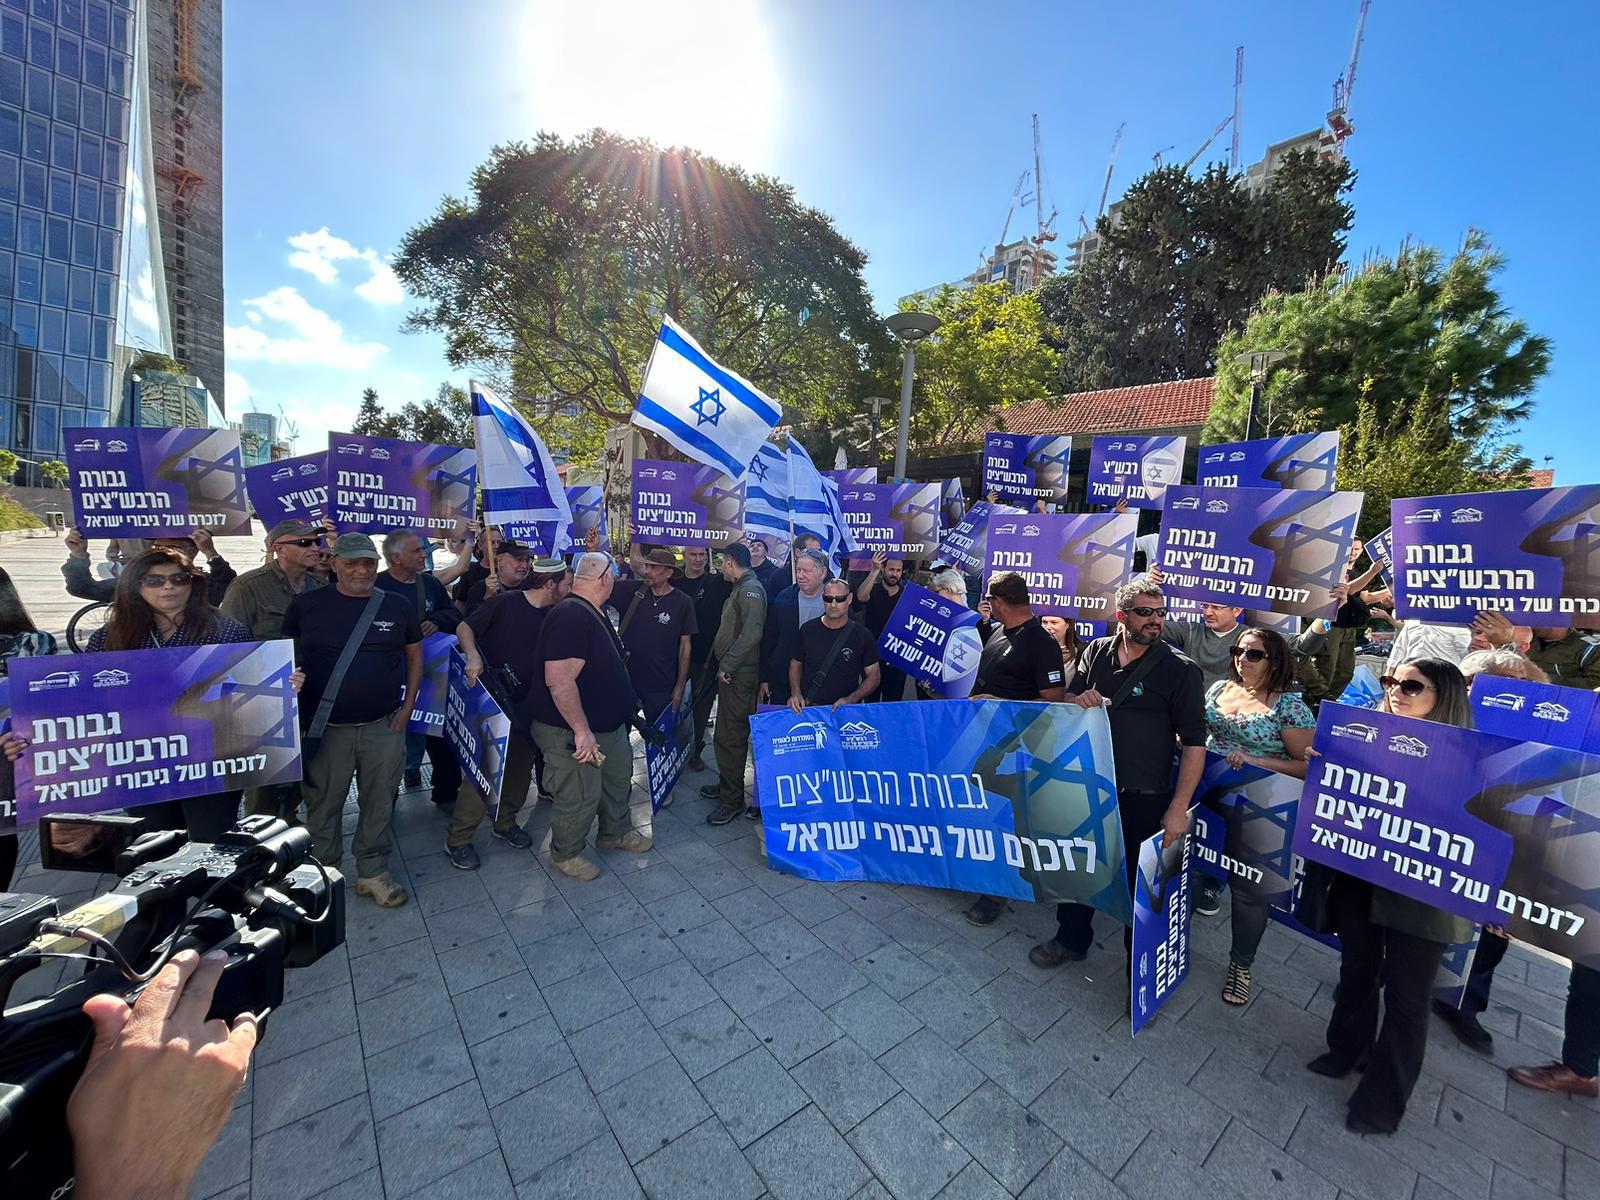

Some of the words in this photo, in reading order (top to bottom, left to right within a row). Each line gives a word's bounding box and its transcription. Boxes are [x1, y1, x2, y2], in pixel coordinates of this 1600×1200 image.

[988, 456, 1009, 469] גבורת
[1103, 461, 1138, 475] רבש"צ
[79, 470, 127, 488] גבורת
[337, 470, 383, 490] גבורת
[987, 469, 1027, 484] הרבש"צים
[1005, 485, 1020, 495] גיבורי
[1021, 487, 1032, 496] של
[1033, 488, 1054, 497] לזכרם
[1092, 482, 1124, 497] ישראל
[1126, 486, 1145, 499] מגן
[82, 491, 171, 510] הרבש"צים
[278, 485, 328, 512] בש"צ
[337, 490, 417, 512] הרבש"צים
[638, 491, 671, 506] גבורת
[84, 514, 124, 528] ישראל
[126, 514, 160, 527] גיבורי
[163, 513, 185, 526] של
[188, 513, 226, 526] לזכרם
[336, 510, 374, 524] ישראל
[377, 514, 406, 527] גיבורי
[408, 516, 425, 528] של
[428, 519, 457, 530] לזכרם
[638, 508, 696, 525] הרבש"צים
[637, 525, 664, 536] ישראל
[666, 528, 688, 539] גיבורי
[689, 529, 703, 539] של
[705, 530, 729, 541] לזכרם
[1166, 528, 1217, 549] גבורת
[888, 543, 900, 552] של
[902, 543, 924, 552] לזכרם
[1405, 544, 1473, 564] גבורת
[992, 550, 1032, 567] גבורת
[1164, 549, 1254, 576] הרבש"צים
[1162, 571, 1198, 588] ישראל
[1202, 578, 1236, 595] גיבורי
[1406, 568, 1535, 590] הרבש"צים
[1240, 581, 1262, 597] של
[1265, 586, 1311, 604] לזכרם
[1028, 593, 1050, 605] גיבור
[1054, 594, 1071, 607] של
[1074, 596, 1107, 609] לזכרם
[1406, 594, 1460, 609] ישראל
[1467, 595, 1514, 612] גיבורי
[1520, 597, 1552, 612] של
[1559, 597, 1600, 613] כרם
[904, 614, 946, 646] רבש"צ
[884, 632, 923, 663] ישראל
[920, 655, 944, 678] מגן
[32, 711, 121, 745] גבורת
[424, 714, 445, 726] כרם
[34, 734, 189, 777] הרבש"צים
[175, 762, 207, 782] של
[212, 753, 268, 777] לזכרם
[115, 769, 170, 790] גיבורי
[1320, 762, 1407, 808] גבורת
[34, 777, 109, 804] ישראל
[776, 769, 900, 809] הרבש"צים
[909, 772, 989, 810] גבורת
[780, 820, 867, 853] ישראל
[1315, 792, 1475, 866] הרבש"צים
[874, 821, 943, 857] גיבורי
[947, 824, 996, 862] של
[1310, 823, 1377, 858] ישראל
[1002, 832, 1097, 874] לזכרם
[1196, 843, 1217, 863] של
[1220, 854, 1264, 884] לזכרם
[1382, 850, 1444, 887] גיבורי
[1450, 871, 1490, 903] של
[1495, 889, 1586, 937] לזכרם
[1167, 890, 1179, 987] הרבש"צים
[1156, 940, 1168, 999] גבורת
